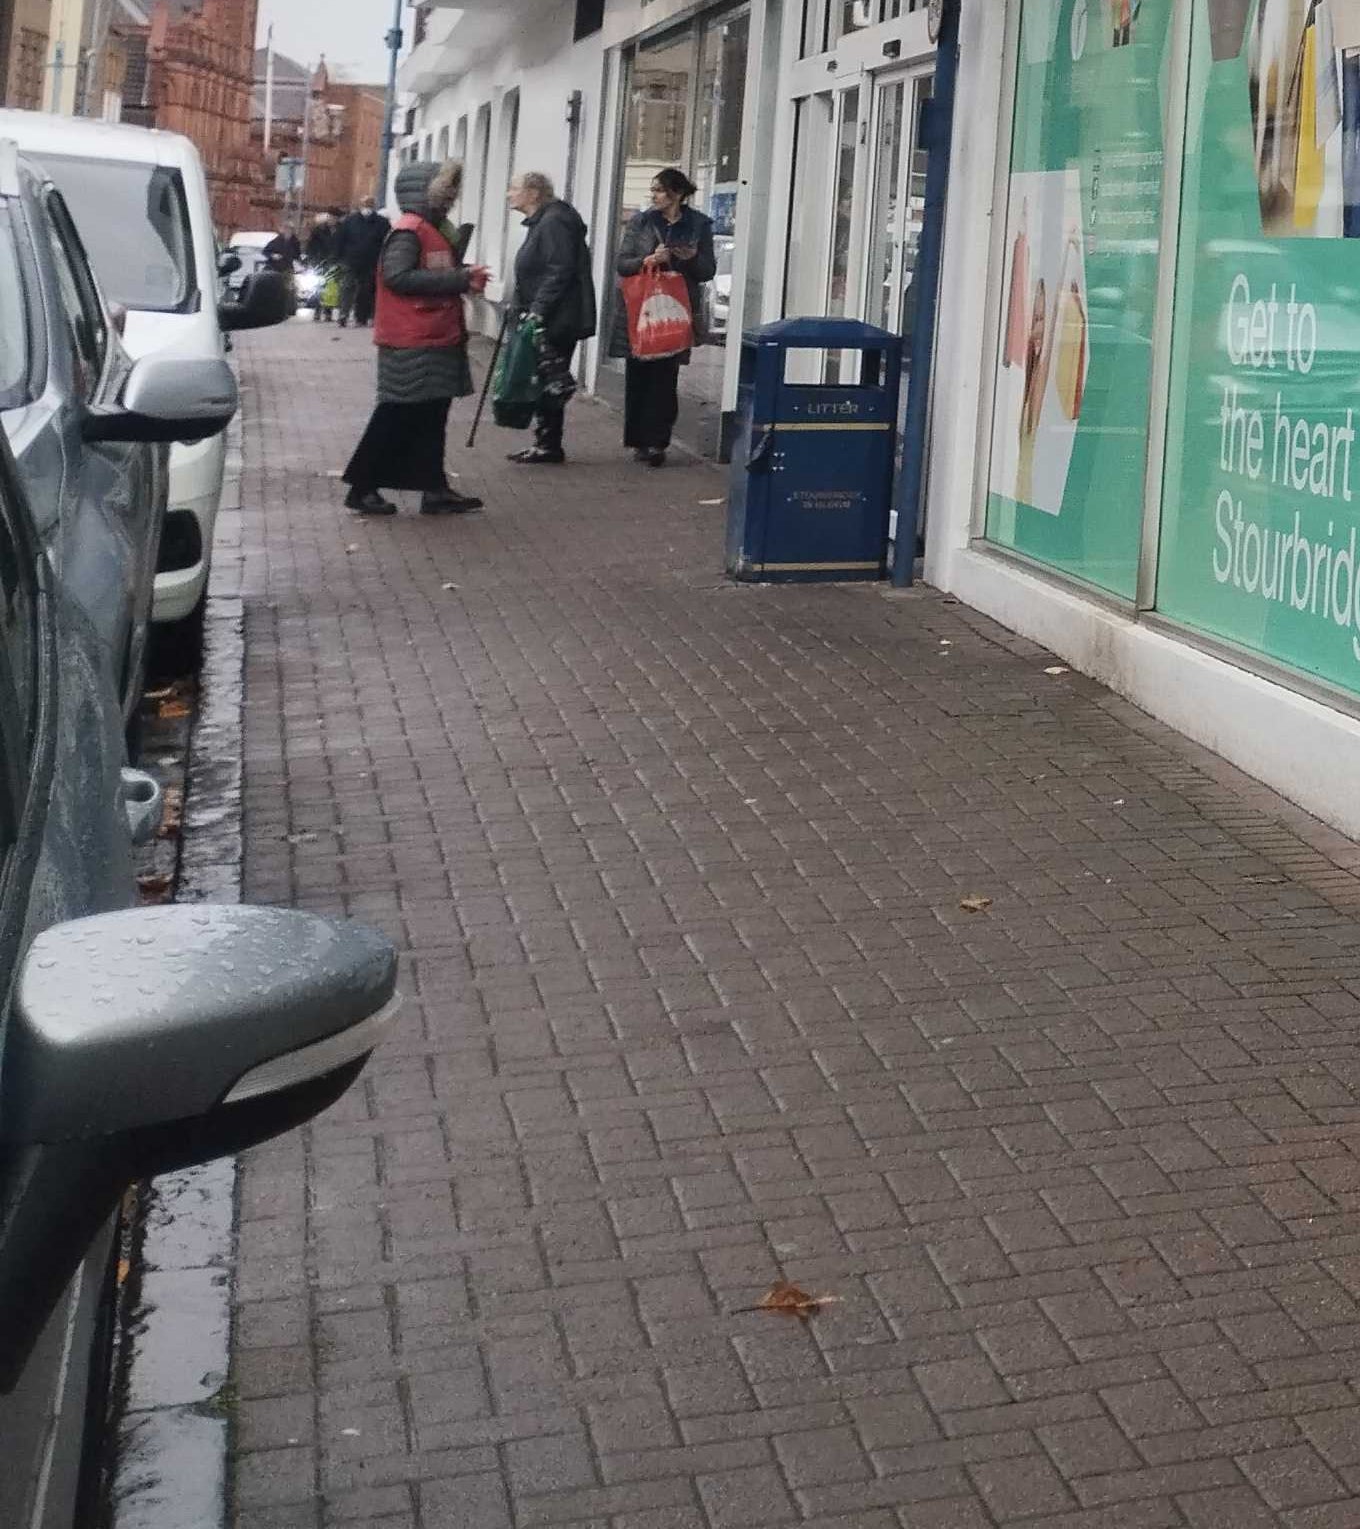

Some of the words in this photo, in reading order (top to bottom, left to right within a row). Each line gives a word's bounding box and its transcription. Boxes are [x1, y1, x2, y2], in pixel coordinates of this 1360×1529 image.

[1225, 272, 1278, 368] Get
[1287, 282, 1316, 374] to
[808, 402, 859, 414] LITTER
[1219, 384, 1264, 479] the
[1272, 391, 1354, 502] heart
